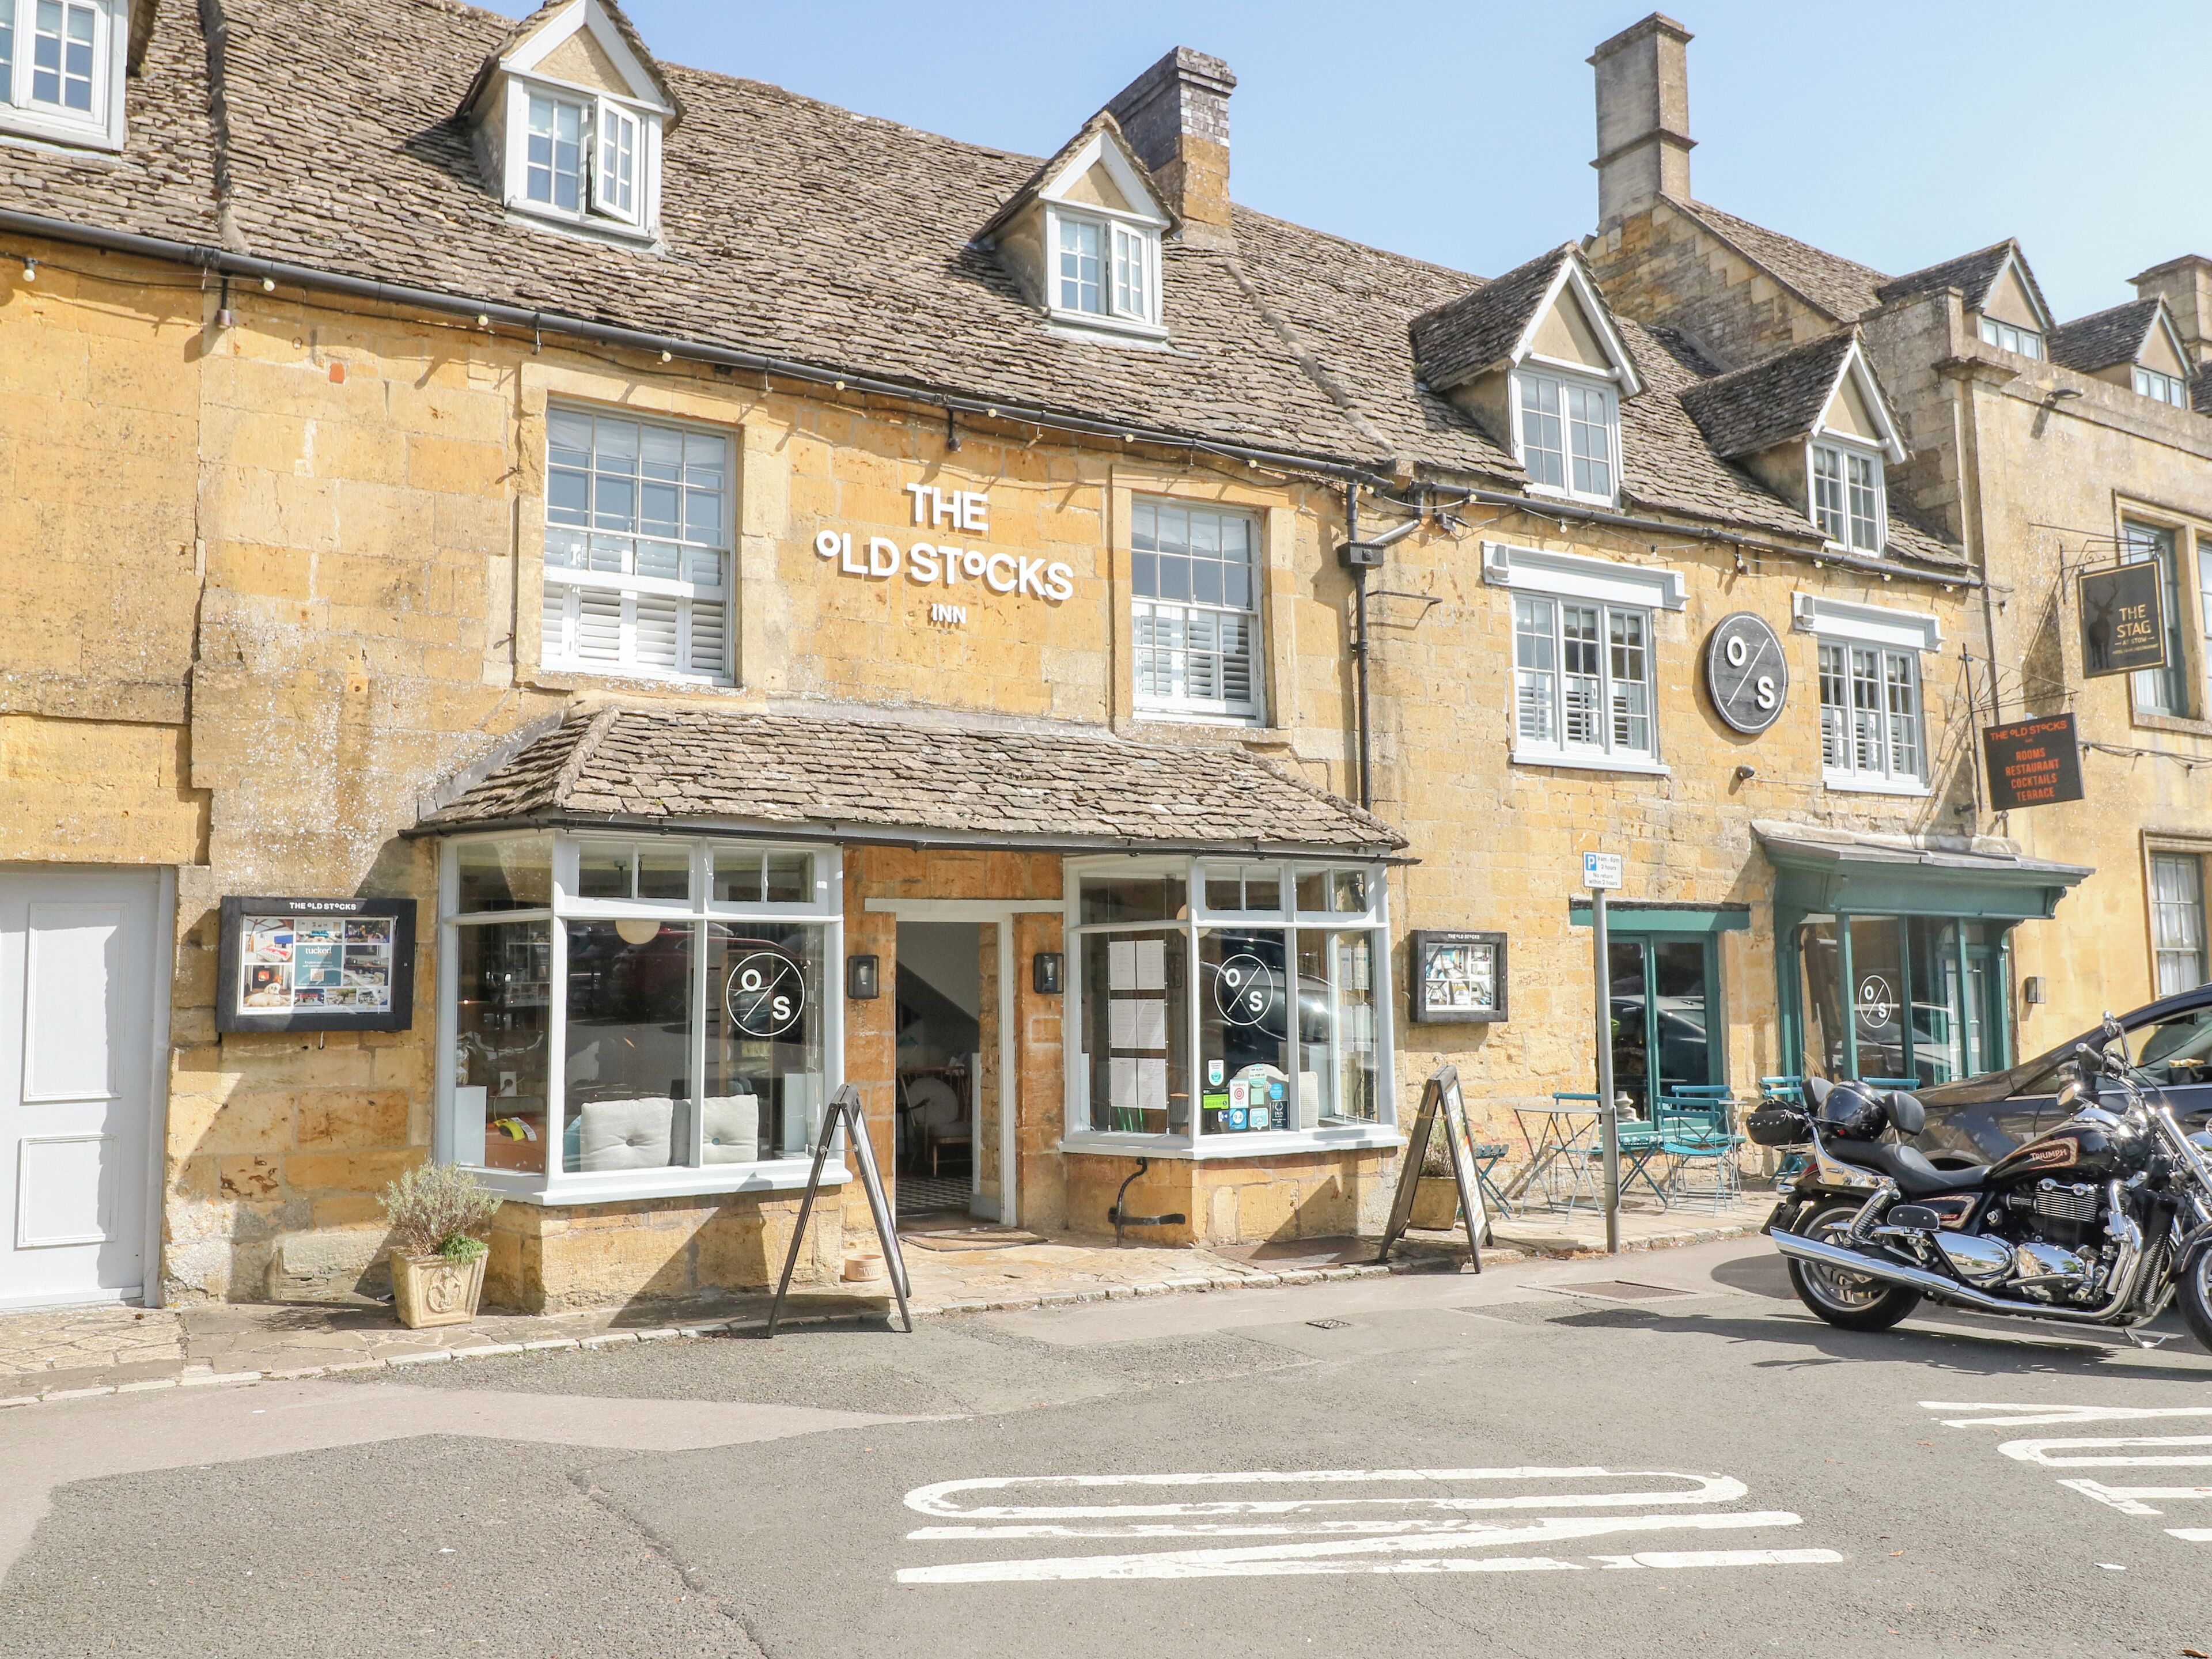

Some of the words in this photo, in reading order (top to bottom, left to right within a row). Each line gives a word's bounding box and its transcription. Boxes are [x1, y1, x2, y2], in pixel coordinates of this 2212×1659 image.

[907, 483, 988, 531] THE
[816, 529, 900, 577] OLD
[910, 542, 1074, 600] STOCKS
[932, 603, 966, 624] INN
[2119, 604, 2146, 621] THE
[2117, 620, 2152, 638] STAG
[1990, 730, 2009, 741] THE
[2010, 727, 2028, 737] OLD
[2029, 720, 2067, 734] STOCKS
[2016, 747, 2046, 761] ROOMS
[2005, 759, 2059, 777] RESTAURANT
[2011, 773, 2058, 789] COCKTAILS
[2017, 787, 2055, 801] TERRACE
[1588, 855, 1595, 869] P
[305, 946, 332, 955] tucked
[2030, 1149, 2067, 1161] TRIUMPH
